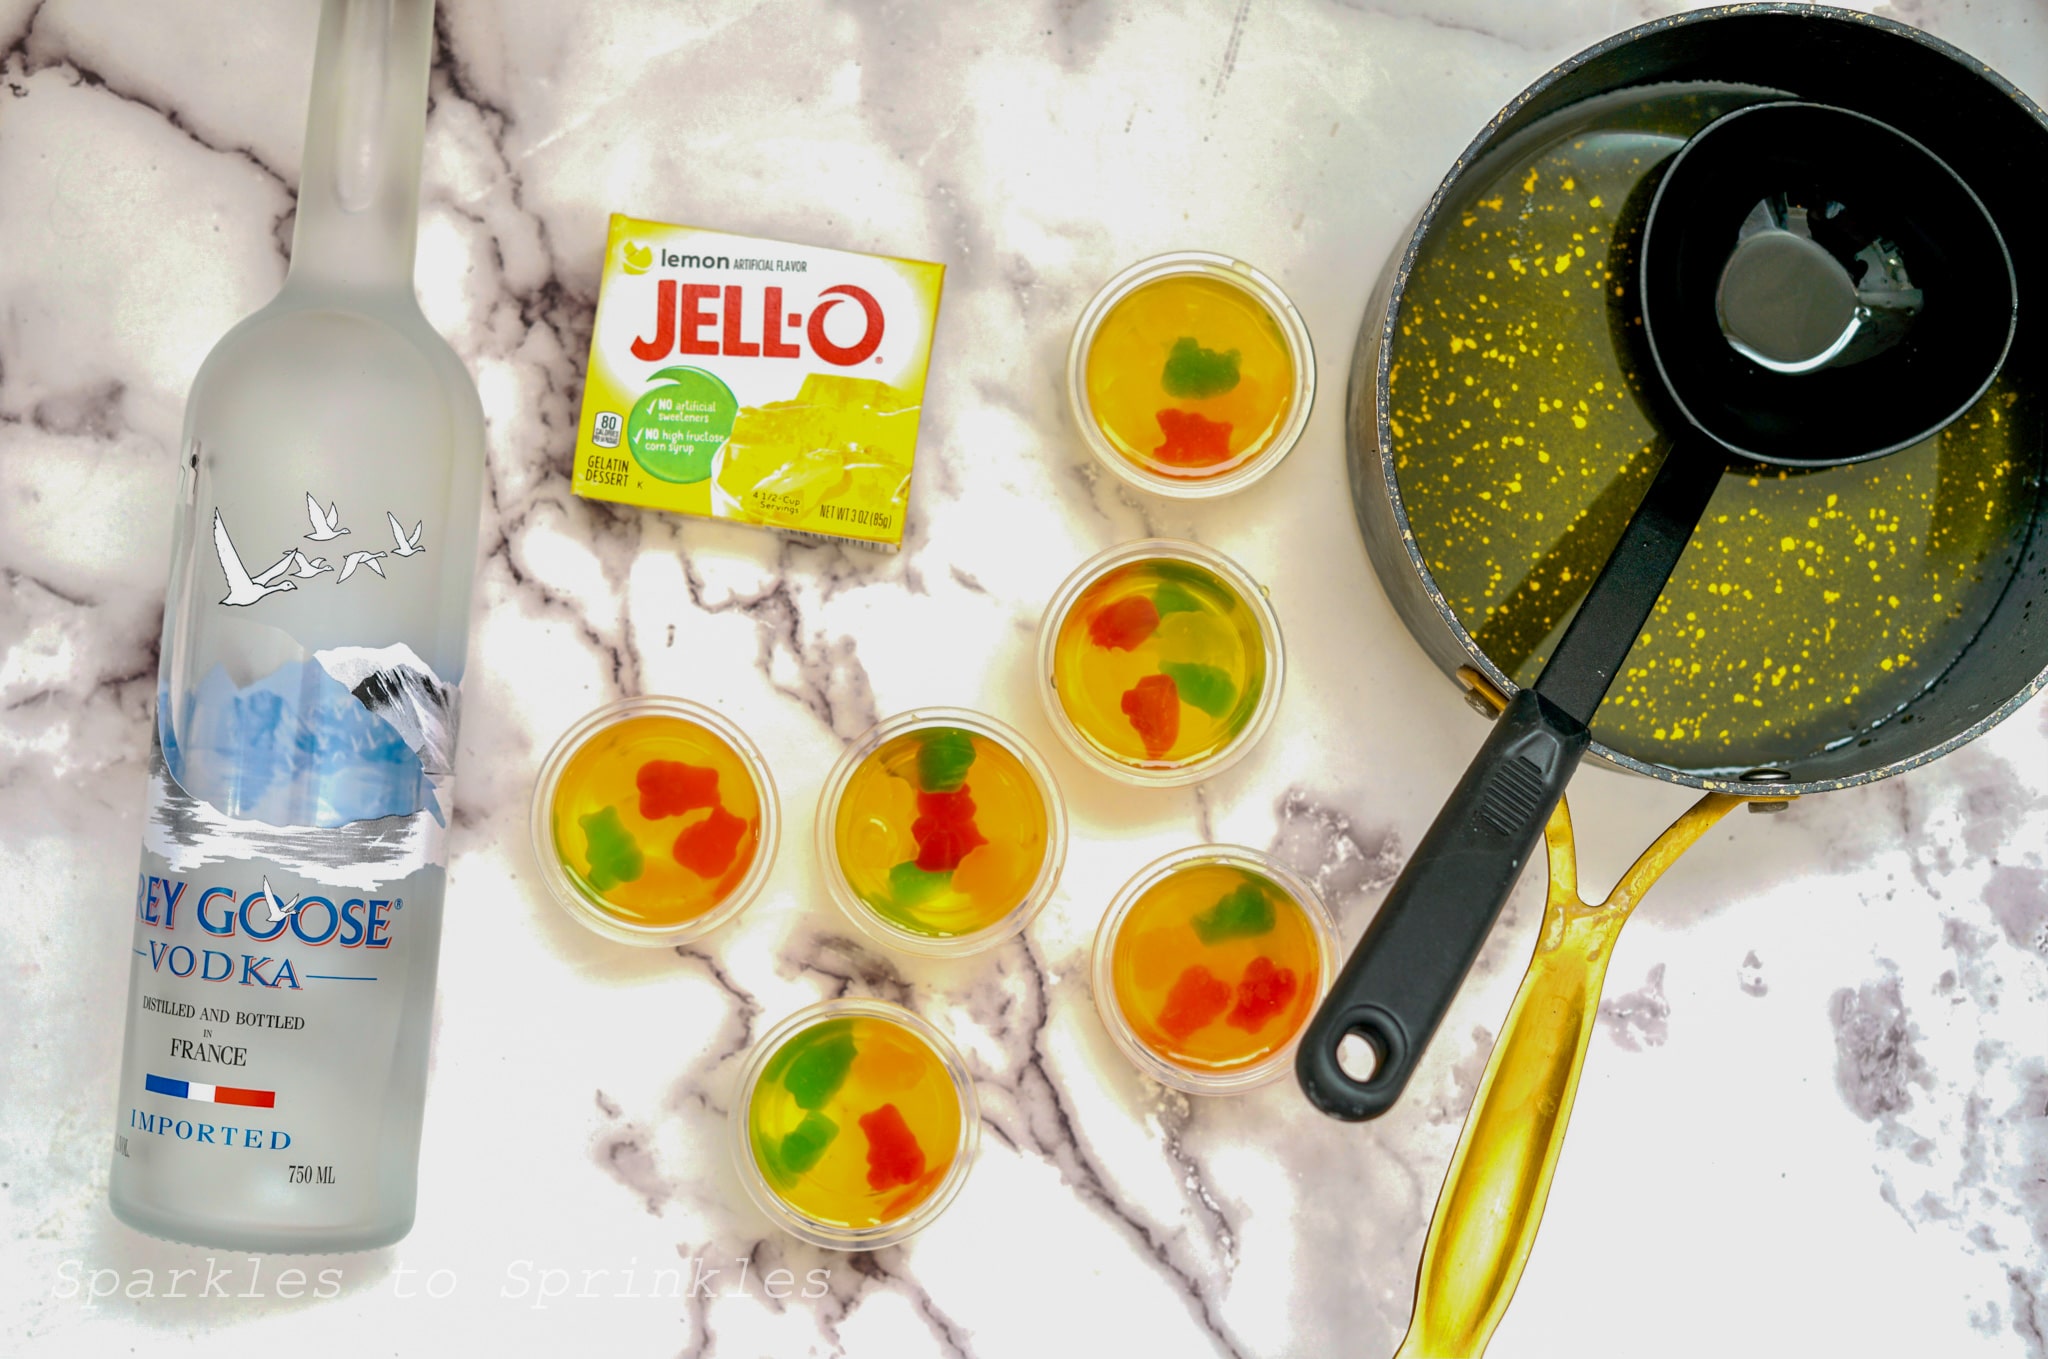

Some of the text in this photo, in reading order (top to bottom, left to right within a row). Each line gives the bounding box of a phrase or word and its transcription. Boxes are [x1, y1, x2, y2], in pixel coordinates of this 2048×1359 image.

[661, 248, 807, 273] lemon ARTIFICIAL FLAVOR
[630, 279, 885, 366] JELL-O
[658, 398, 716, 412] NO artificial
[601, 415, 617, 430] 80
[658, 412, 709, 423] sweeteners
[645, 428, 724, 444] NO high fructose
[645, 442, 695, 456] corn syrup
[587, 455, 629, 473] GELATIN
[585, 469, 629, 487] DESSERT
[752, 491, 759, 499] 4
[760, 501, 799, 514] Servings
[820, 504, 892, 529] NET WT 3 OZ (85g)
[137, 872, 395, 949] REY GOOSE
[149, 939, 303, 990] VODKA
[143, 995, 305, 1031] DISTILLED AND BOTTLED
[203, 1029, 213, 1039] IN
[170, 1037, 248, 1067] FRANCE
[130, 1108, 292, 1151] IMPORTED
[288, 1165, 336, 1185] 750 ML
